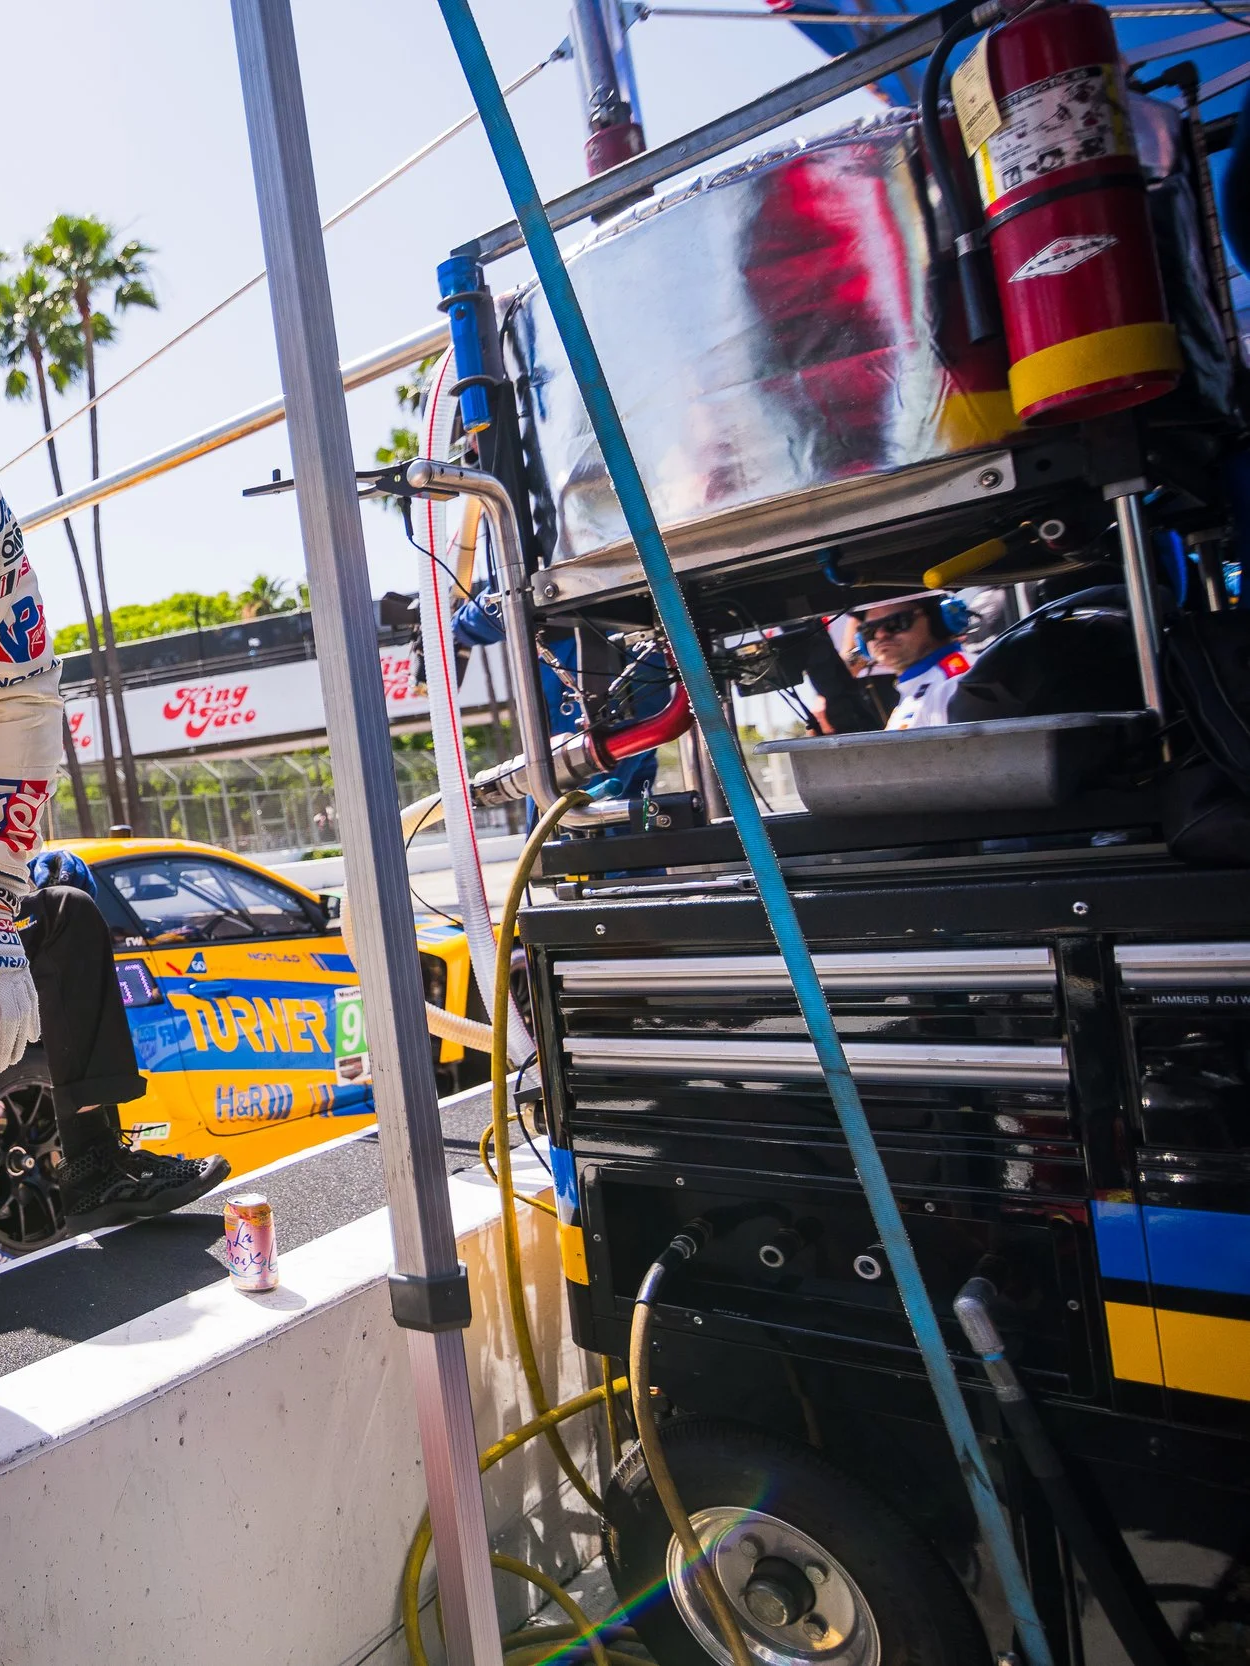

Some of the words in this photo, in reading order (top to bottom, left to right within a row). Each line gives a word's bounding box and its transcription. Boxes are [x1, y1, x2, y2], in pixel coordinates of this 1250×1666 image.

[163, 684, 249, 720] King
[185, 705, 257, 739] Taco
[1151, 995, 1211, 1004] HAMMERS
[1215, 995, 1238, 1004] ADJ
[167, 993, 332, 1053] TURNER
[341, 1003, 367, 1052] 9
